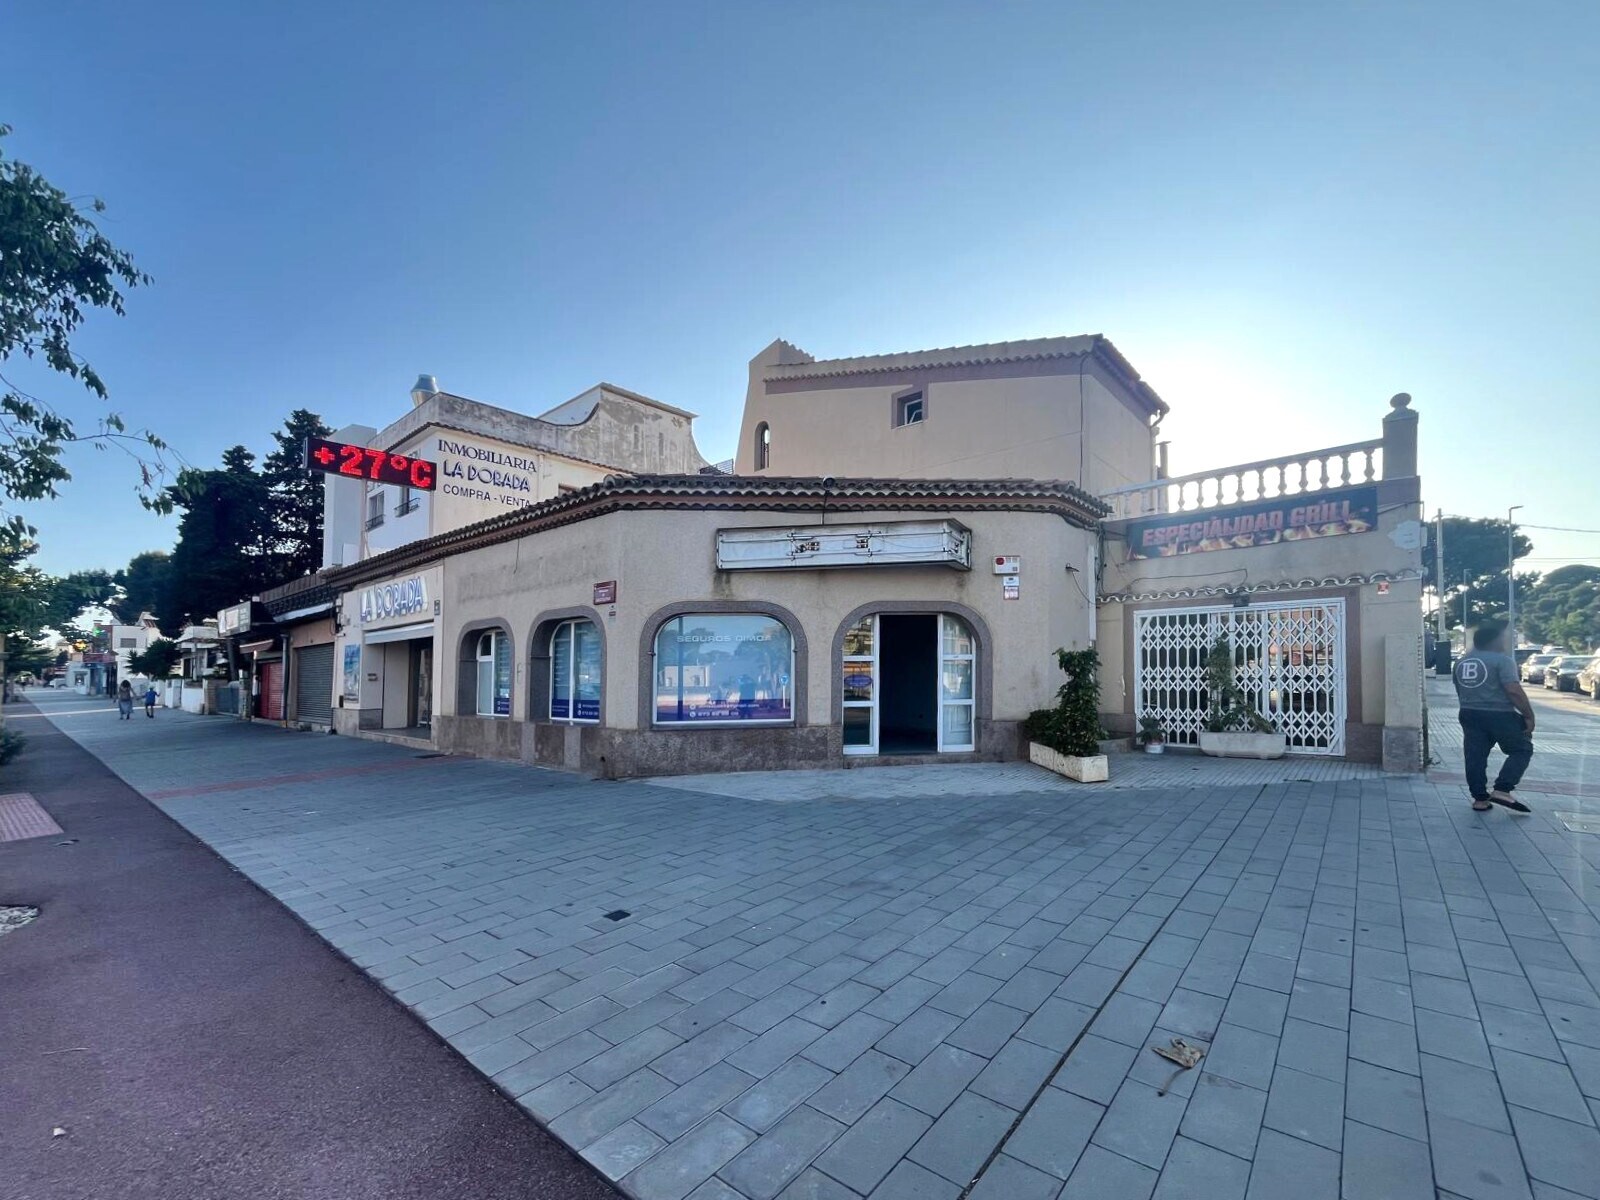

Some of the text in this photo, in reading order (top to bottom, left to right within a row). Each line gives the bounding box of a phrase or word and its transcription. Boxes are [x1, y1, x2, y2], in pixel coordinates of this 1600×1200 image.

[438, 439, 537, 473] INMOBILIARIA
[443, 459, 530, 492] LA DORADA
[443, 483, 491, 501] COMPRA
[1290, 500, 1351, 527] GRILL
[360, 577, 428, 622] LA DORADA
[677, 635, 731, 643] SEGUROS
